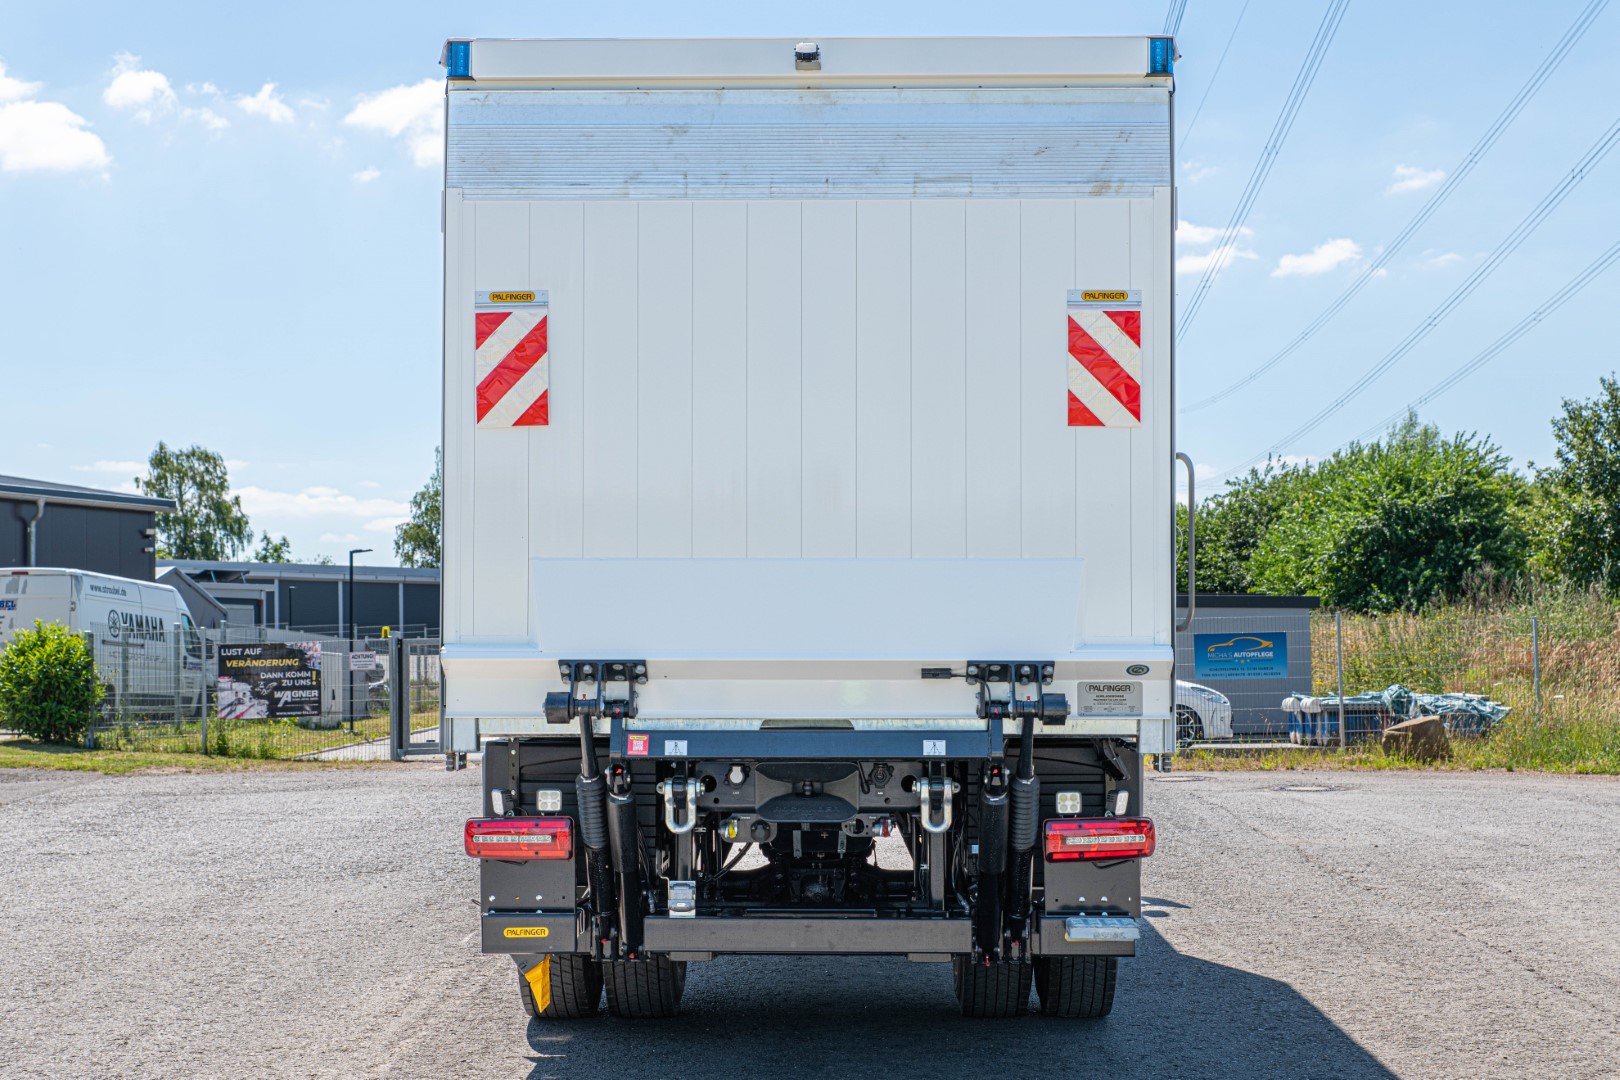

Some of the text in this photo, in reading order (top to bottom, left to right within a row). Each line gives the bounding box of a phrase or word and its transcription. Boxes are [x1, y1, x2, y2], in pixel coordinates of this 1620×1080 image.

[492, 293, 532, 301] PALFINGER
[1084, 292, 1125, 300] PALFINGER
[120, 612, 165, 642] YAMAHA
[221, 647, 262, 656] LUST AUF
[225, 657, 299, 668] VERÄNDERUNG
[260, 671, 284, 679] DANN
[281, 679, 293, 687] ZU
[1088, 684, 1131, 692] PALFINGER
[273, 690, 319, 707] WAGNER
[506, 928, 546, 936] PALFINGER
